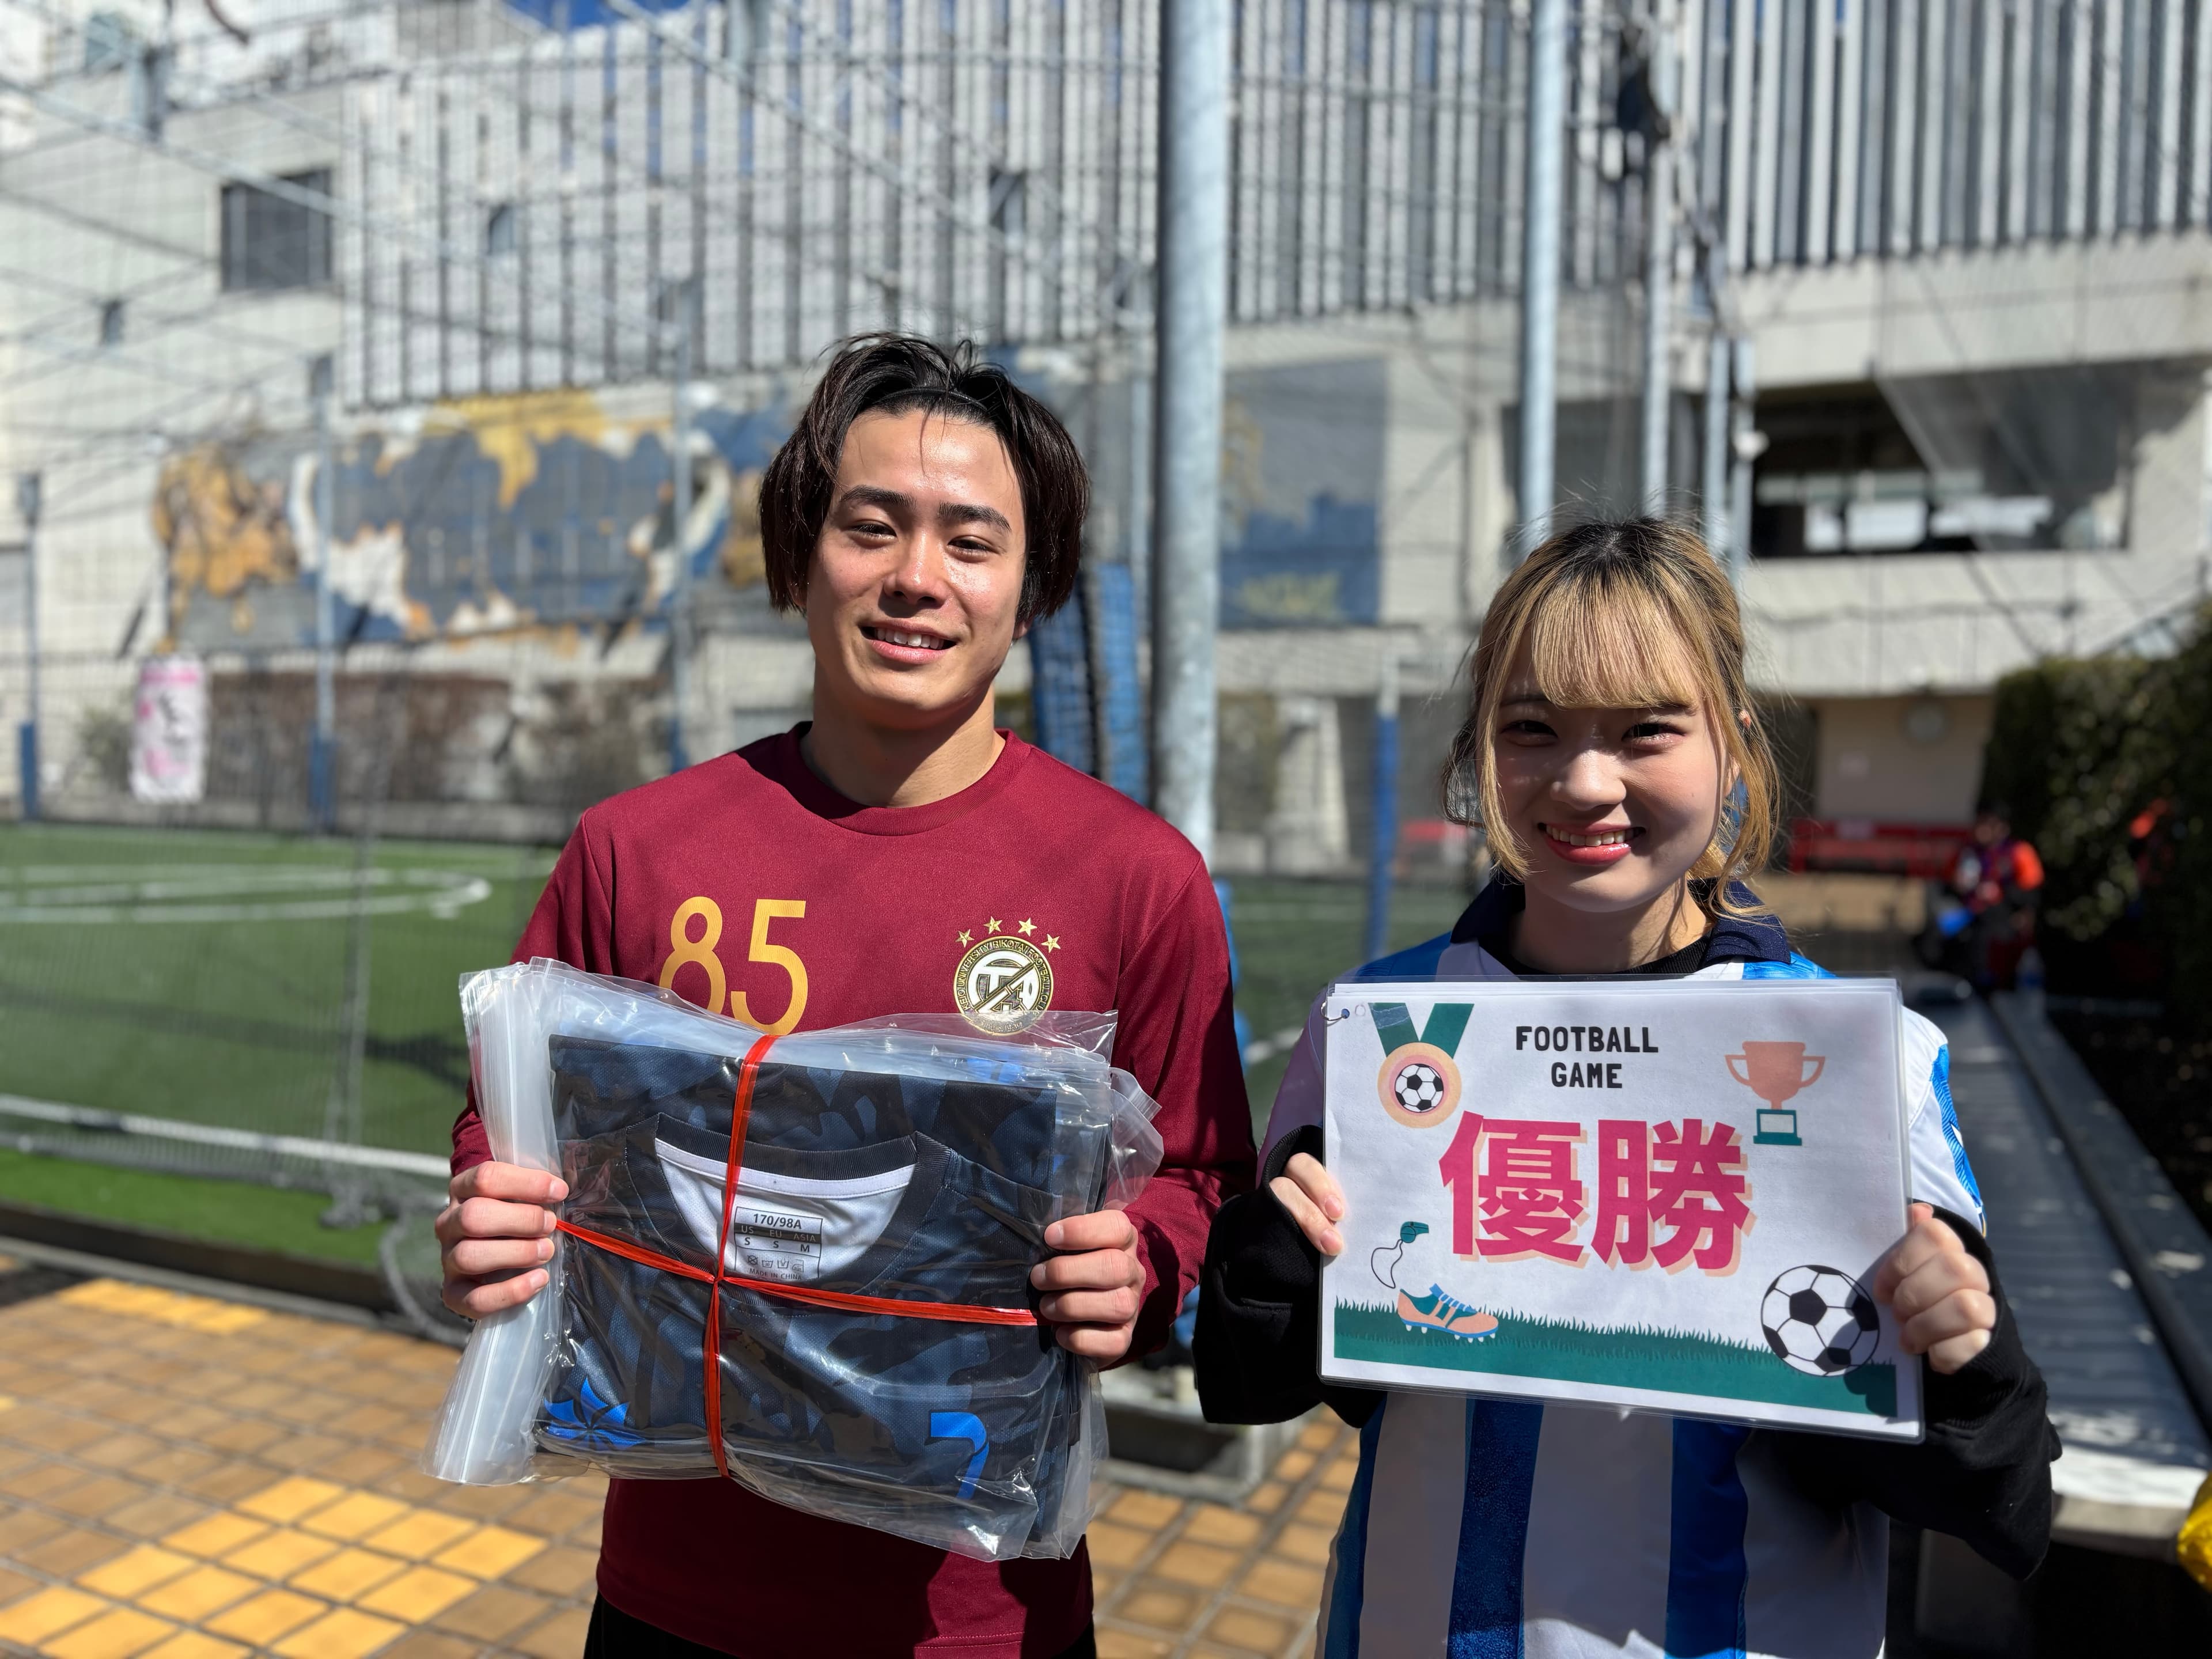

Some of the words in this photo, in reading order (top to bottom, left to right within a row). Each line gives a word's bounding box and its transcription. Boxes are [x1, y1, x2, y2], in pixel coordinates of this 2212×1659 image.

[659, 896, 809, 1036] 85
[957, 942, 991, 987] UNIVERSITY
[1028, 949, 1050, 994] FOOTBALL
[957, 990, 971, 1010] KEIO
[1516, 1025, 1659, 1053] FOOTBALL
[1551, 1062, 1623, 1089] GAME
[1438, 1111, 1754, 1277] 優勝
[741, 1225, 754, 1234] US
[770, 1230, 782, 1238] EU
[793, 1234, 816, 1243] ASIA
[753, 1213, 802, 1229] 170/98A
[744, 1237, 751, 1245] S
[800, 1244, 810, 1253] M
[749, 1268, 768, 1277] MADE
